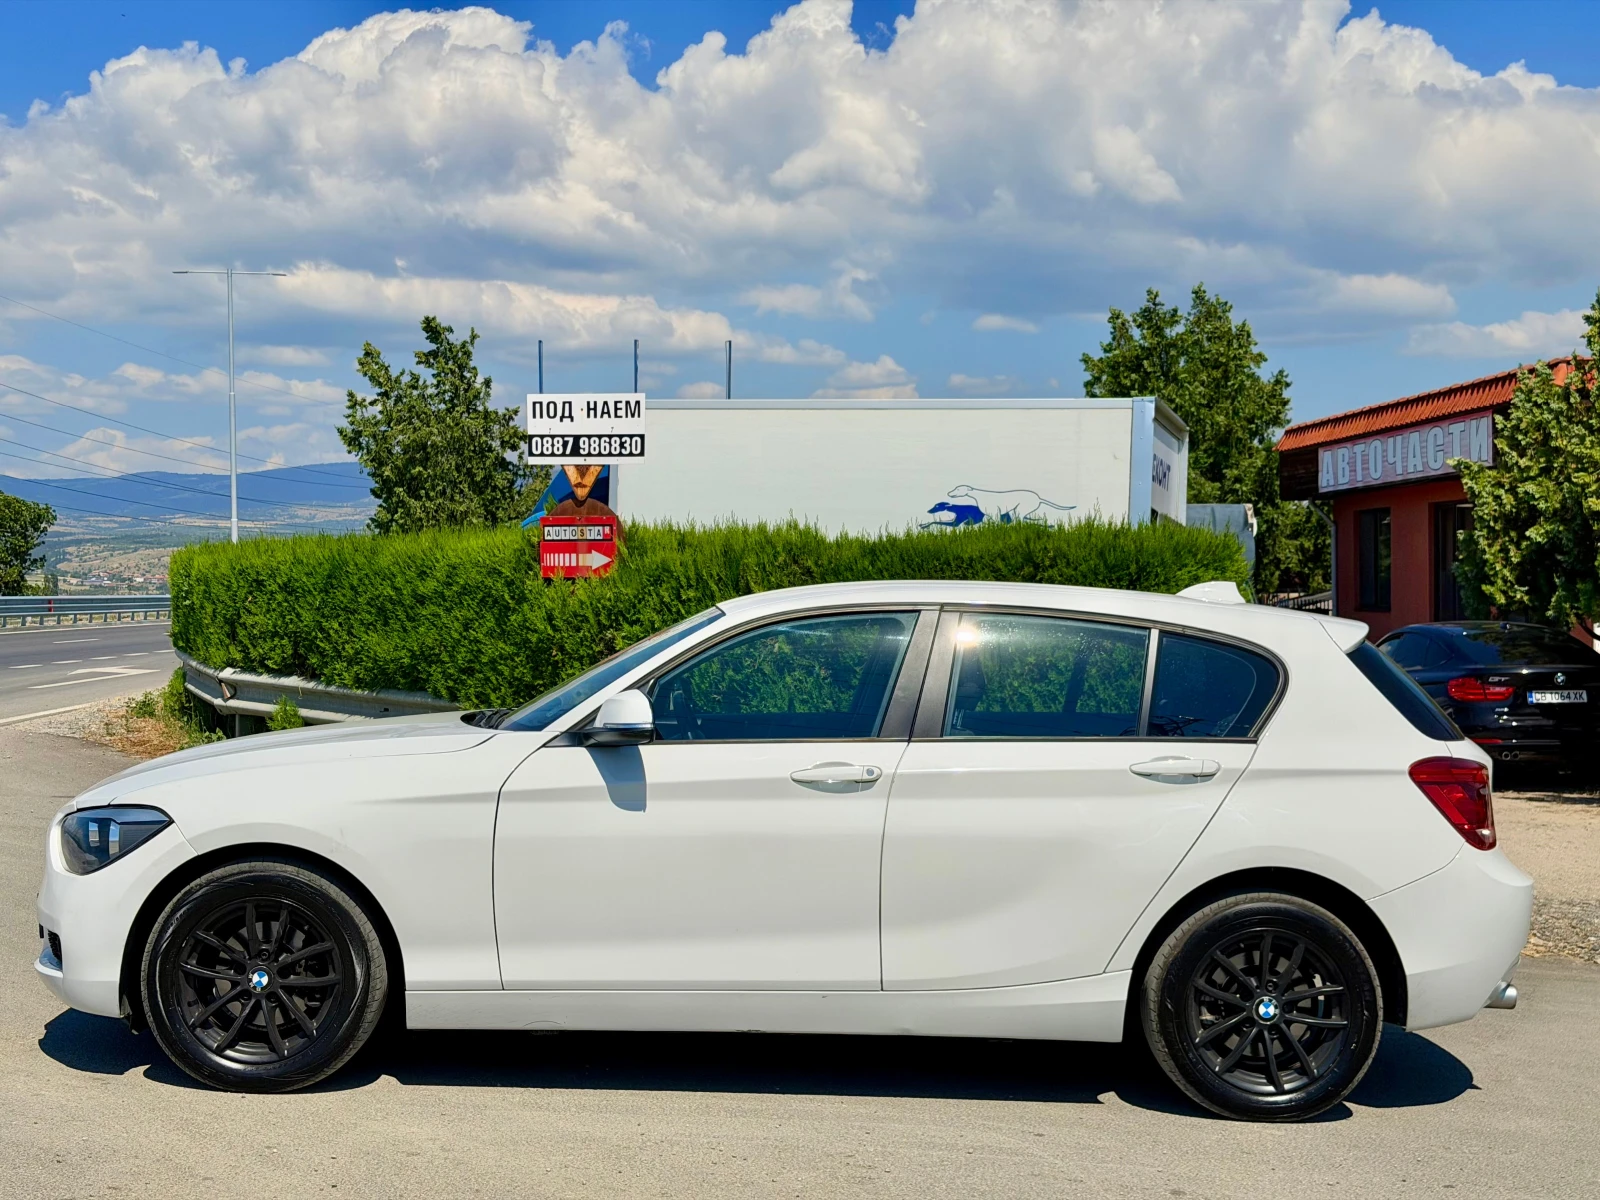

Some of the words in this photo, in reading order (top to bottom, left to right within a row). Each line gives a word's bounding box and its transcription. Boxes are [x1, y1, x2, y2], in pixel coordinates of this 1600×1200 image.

[532, 401, 574, 422] ПОД
[586, 400, 641, 419] НАЕМ
[531, 437, 574, 455] 0887
[579, 436, 642, 455] 986830
[1321, 416, 1489, 489] АВТОЧАСТИ
